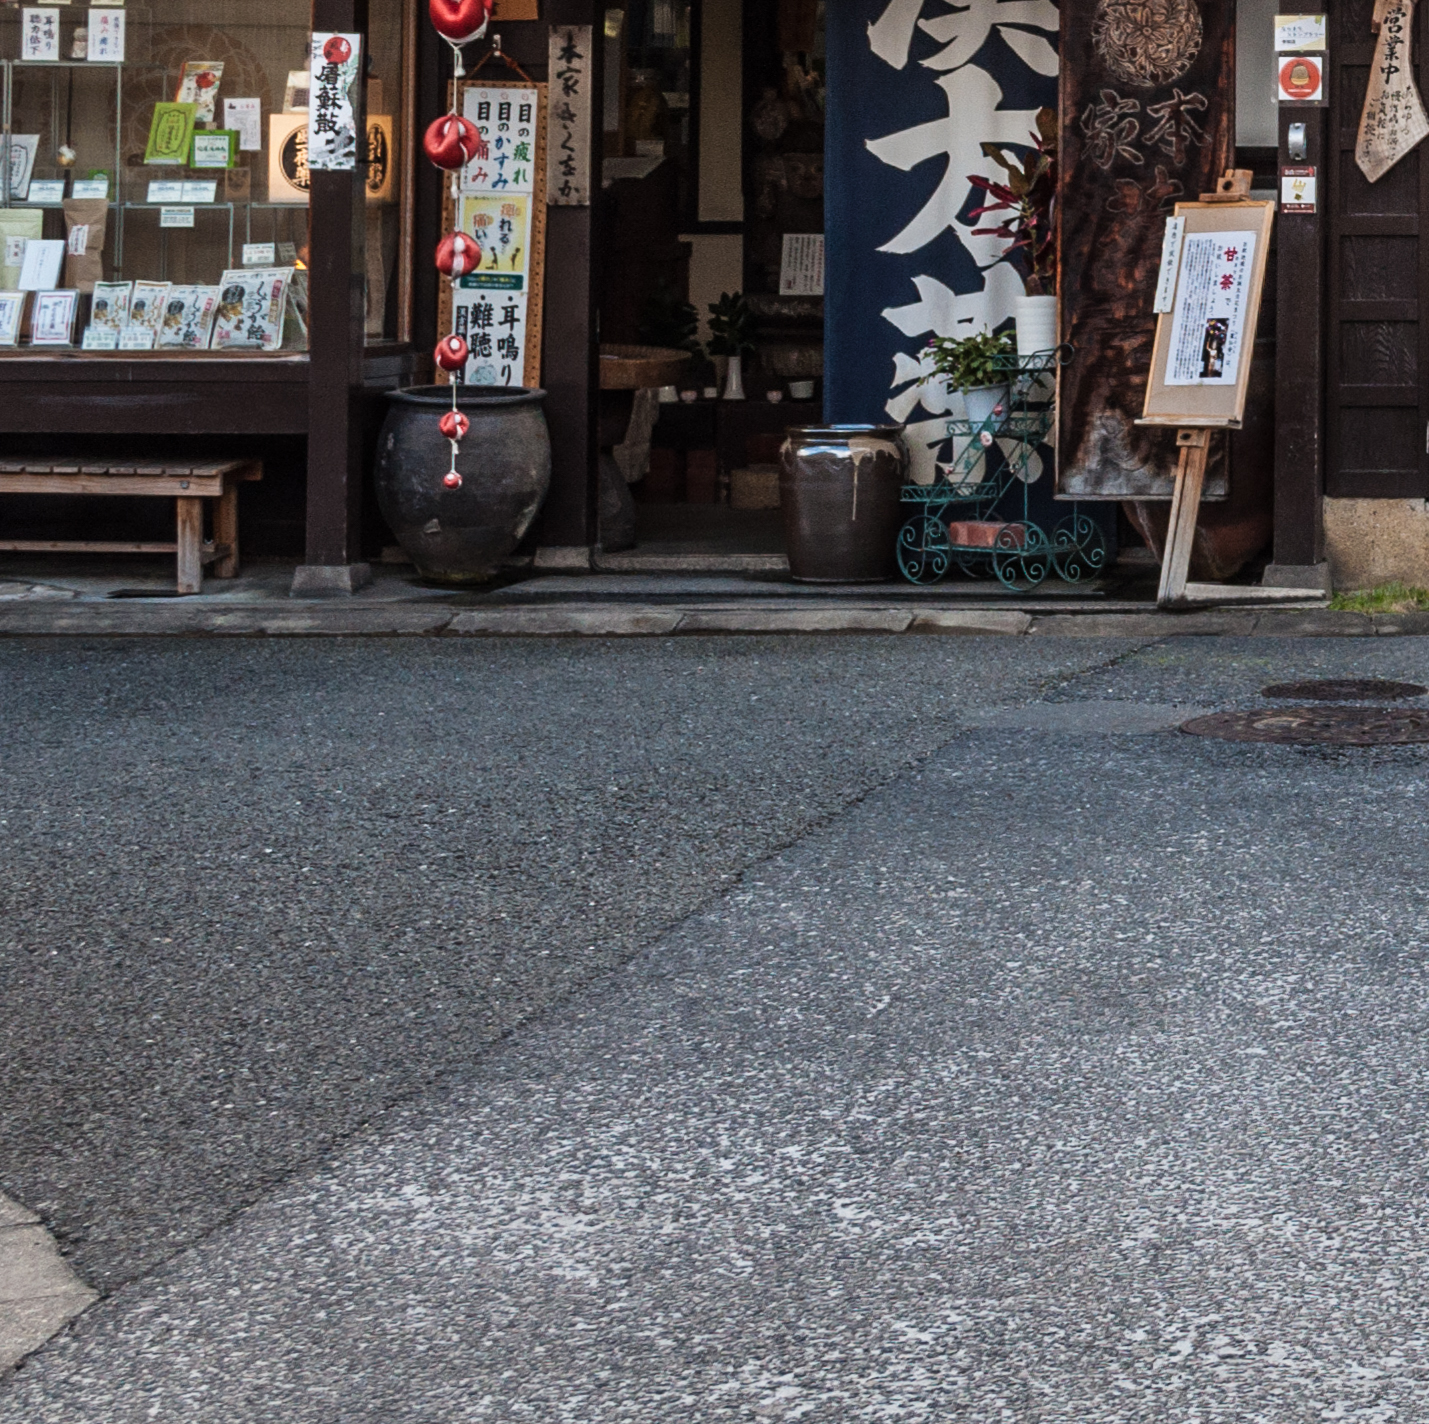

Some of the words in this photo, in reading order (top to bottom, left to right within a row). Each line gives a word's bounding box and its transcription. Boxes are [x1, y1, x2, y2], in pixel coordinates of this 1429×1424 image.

[1381, 6, 1406, 84] 営業中
[315, 62, 342, 136] 屠蘇散
[491, 101, 512, 190] 目のかすみ
[513, 103, 532, 185] 目の疲れ
[469, 302, 495, 359] 難聴
[497, 305, 520, 386] 耳鳴り
